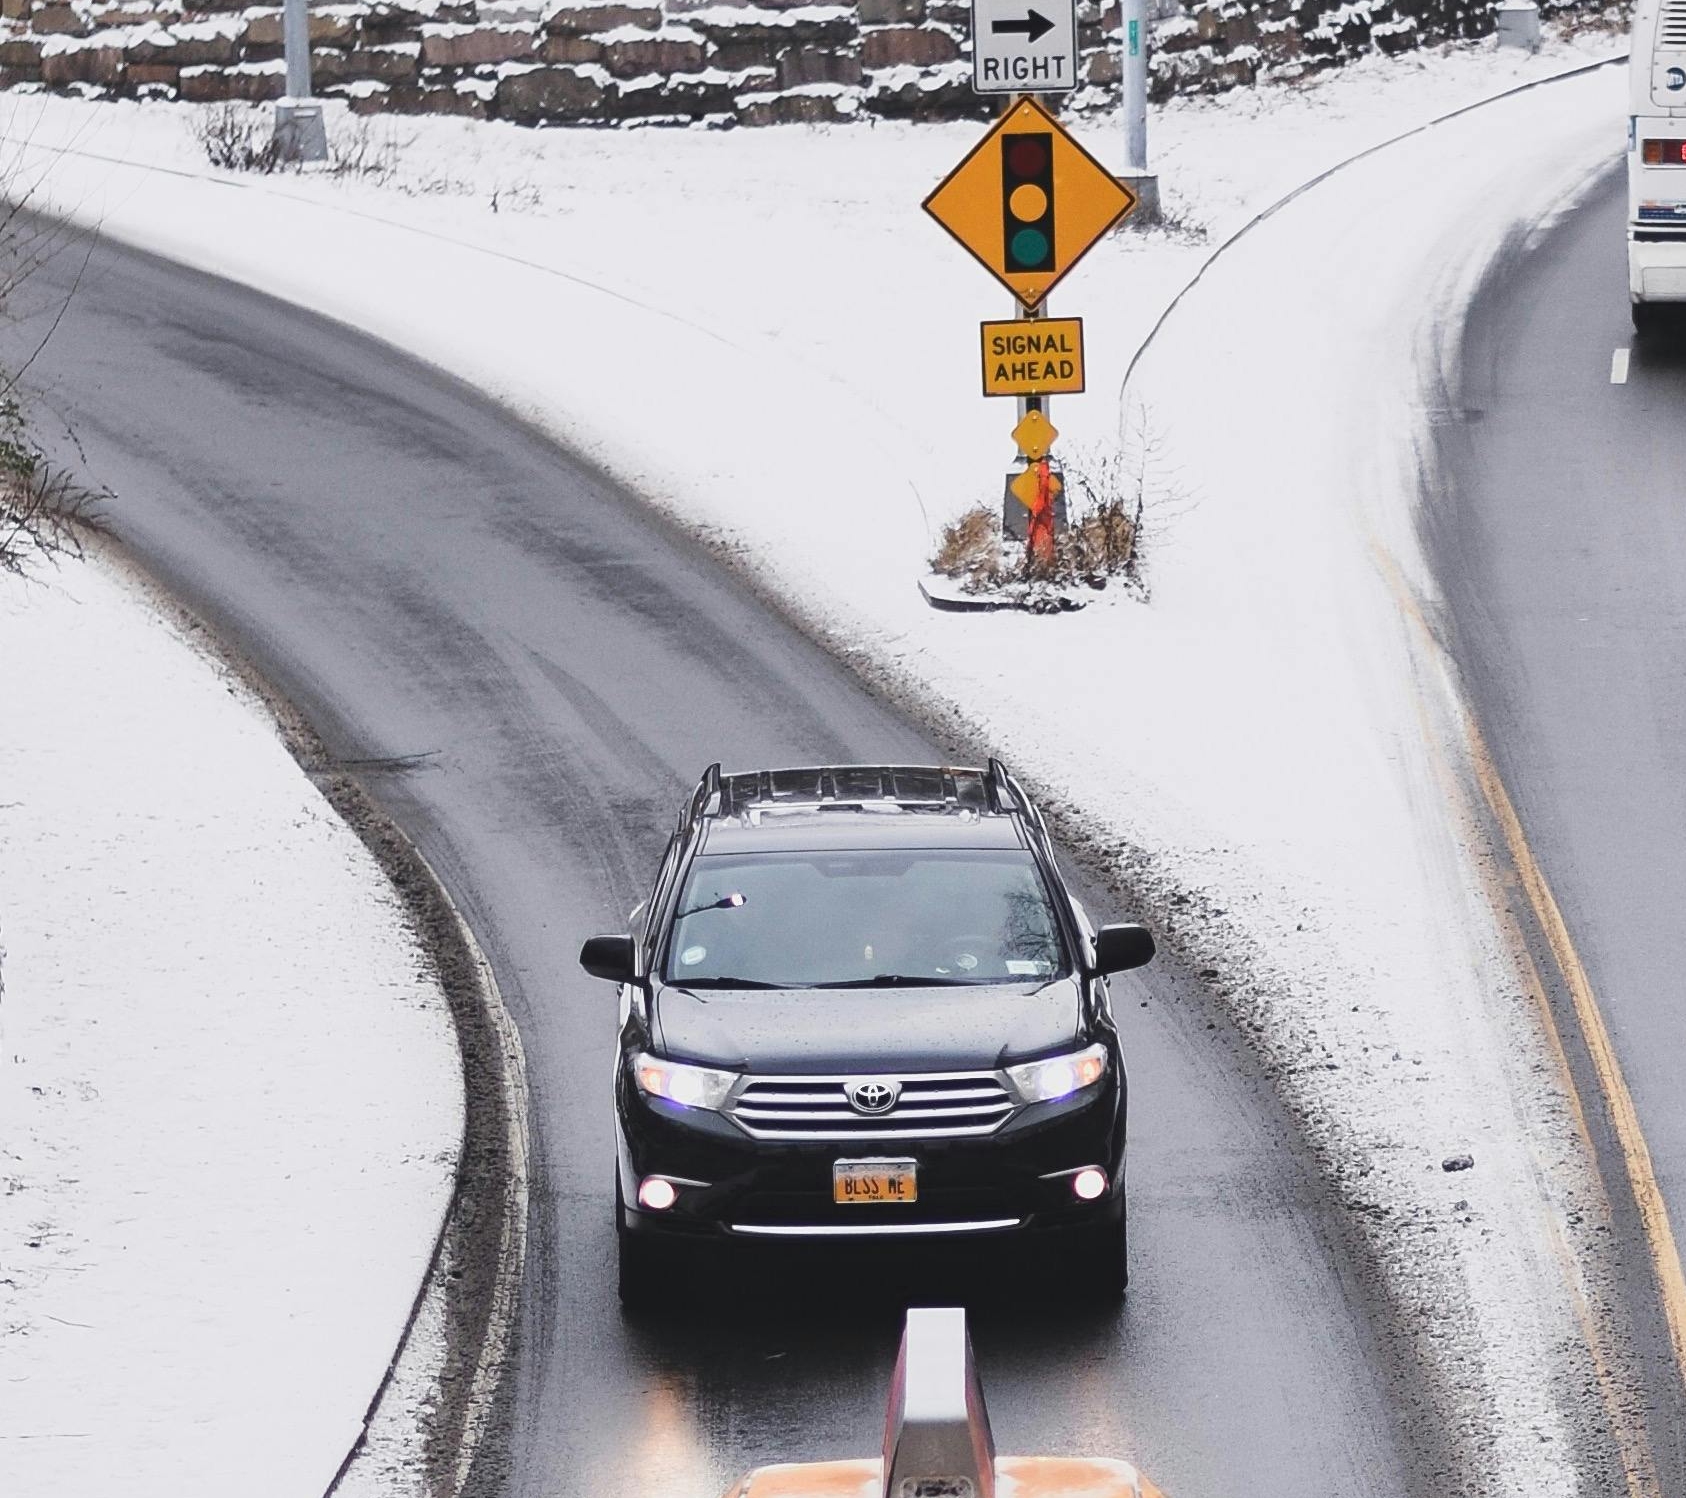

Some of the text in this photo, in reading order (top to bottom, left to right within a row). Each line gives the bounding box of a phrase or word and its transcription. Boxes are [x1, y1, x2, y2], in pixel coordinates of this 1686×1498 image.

[983, 56, 1066, 80] RIGHT
[992, 334, 1073, 356] SIGNAL
[994, 360, 1074, 382] AHEAD
[844, 1175, 880, 1195] BLSS
